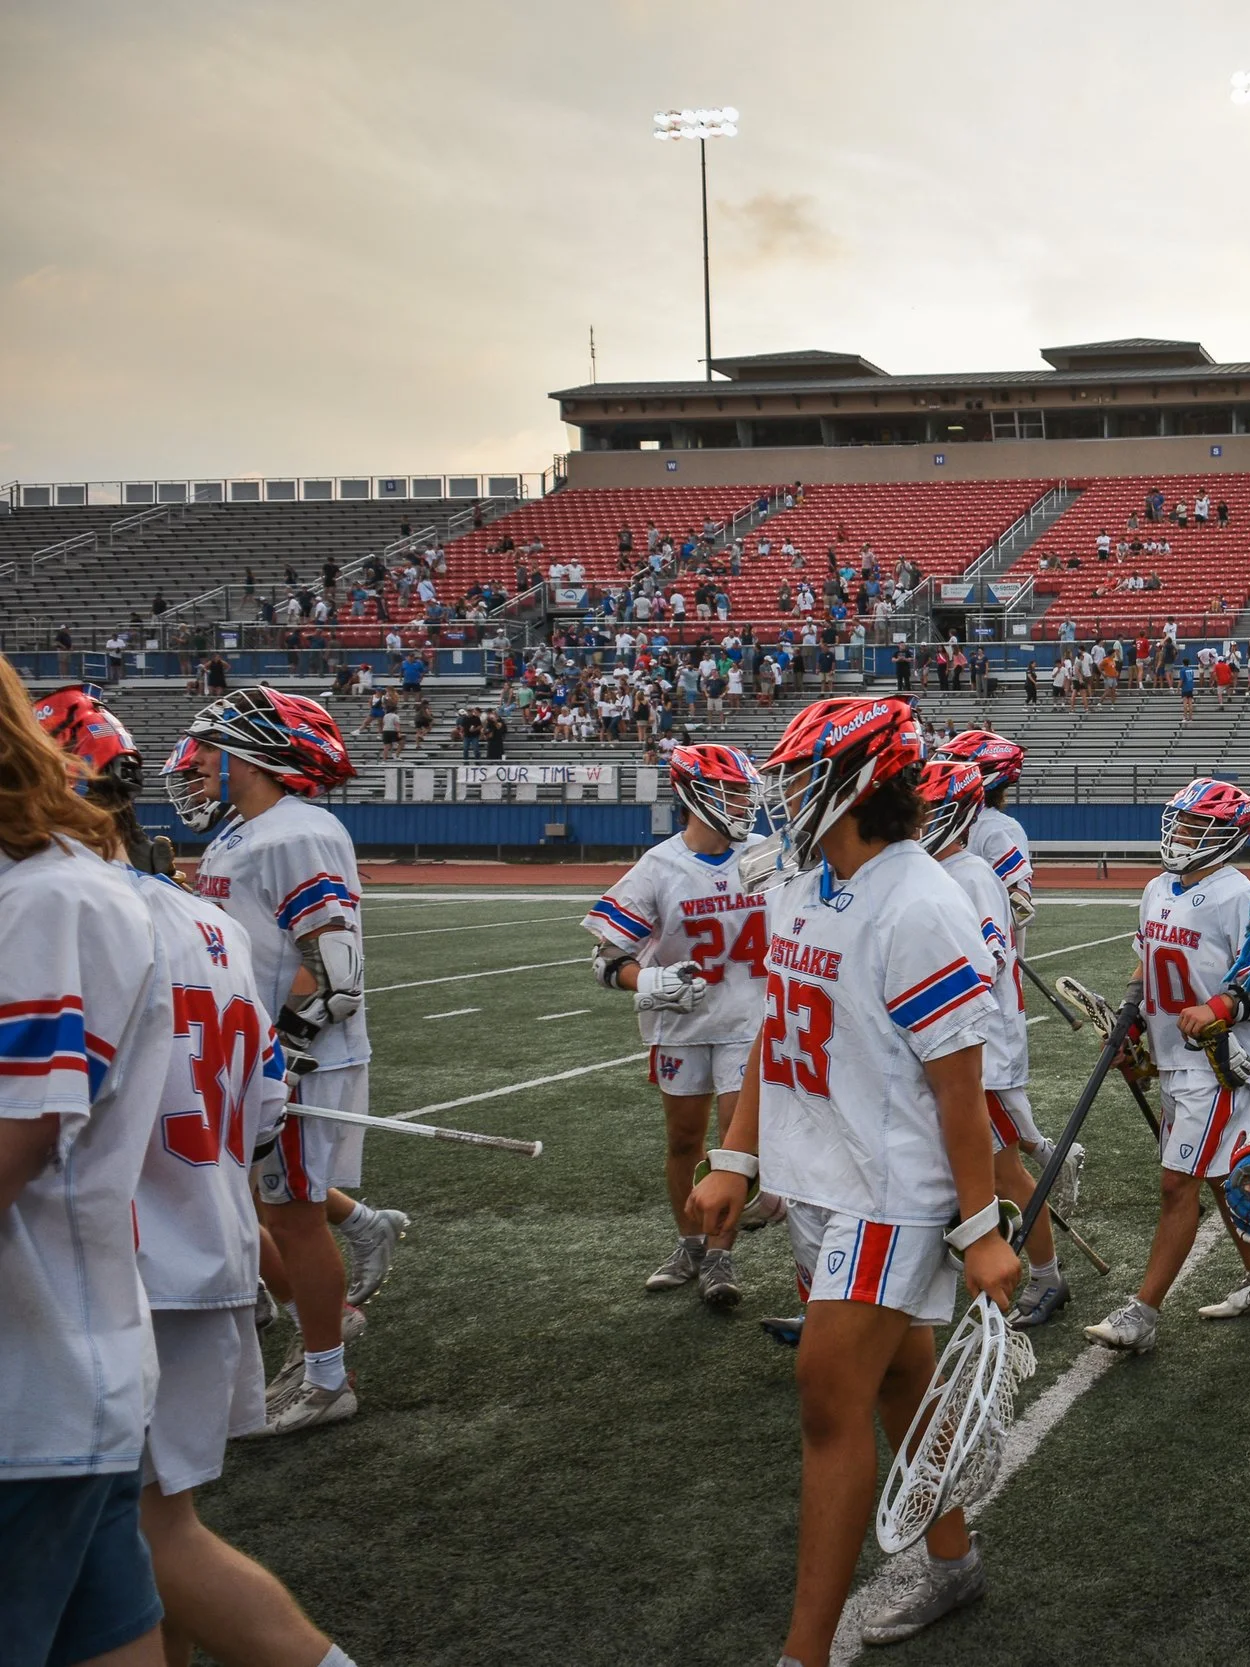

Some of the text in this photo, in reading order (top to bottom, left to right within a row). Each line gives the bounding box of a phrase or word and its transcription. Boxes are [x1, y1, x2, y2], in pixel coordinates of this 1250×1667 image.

[830, 702, 889, 746] Westlake
[465, 766, 602, 783] ITS OUR TIME W
[680, 892, 767, 917] WESTLAKE
[714, 880, 728, 892] W
[682, 910, 771, 984] 24
[1144, 942, 1198, 1016] 10
[762, 970, 835, 1101] 23
[162, 982, 260, 1169] 30
